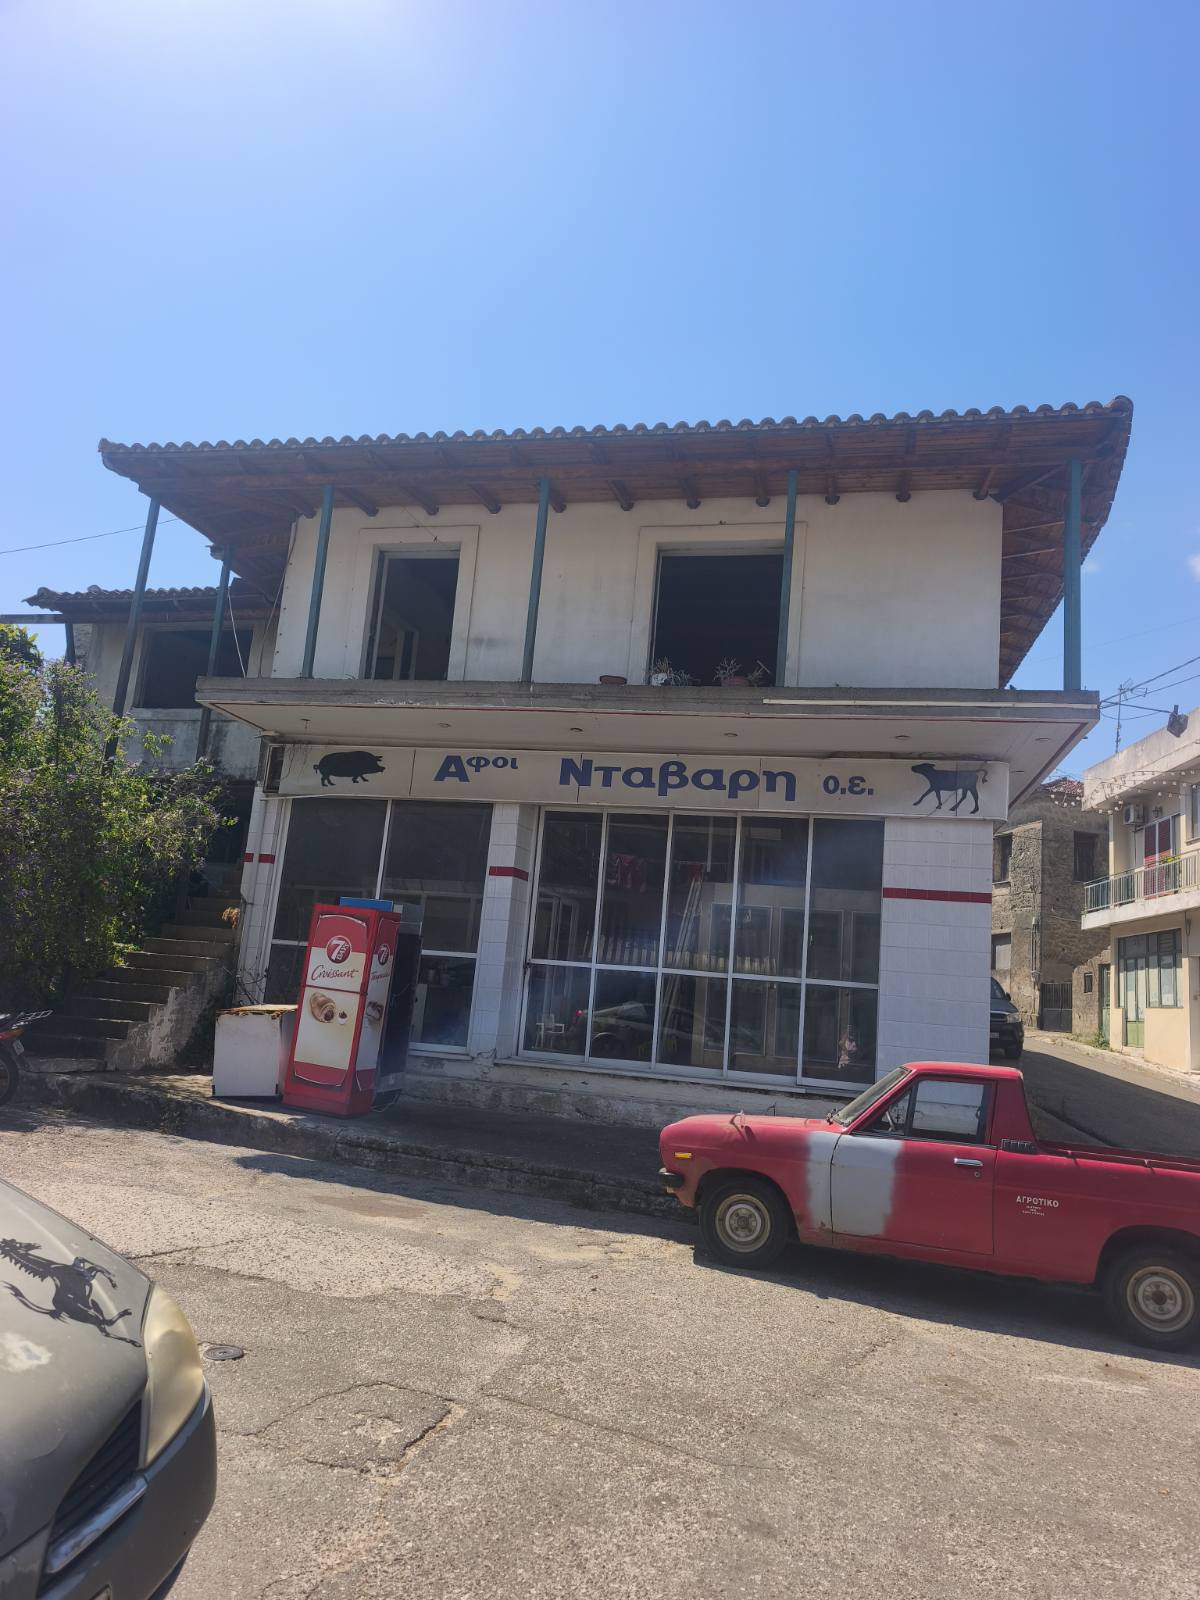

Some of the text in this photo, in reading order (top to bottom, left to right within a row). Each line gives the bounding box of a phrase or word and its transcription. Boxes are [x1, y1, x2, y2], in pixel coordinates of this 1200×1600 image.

[433, 755, 519, 783] Αφοι
[559, 757, 797, 801] Νταβαρη
[331, 939, 346, 960] 7
[311, 964, 359, 981] Croissant
[1016, 1195, 1059, 1208] ΑΓΡΟΤΙΚΟ
